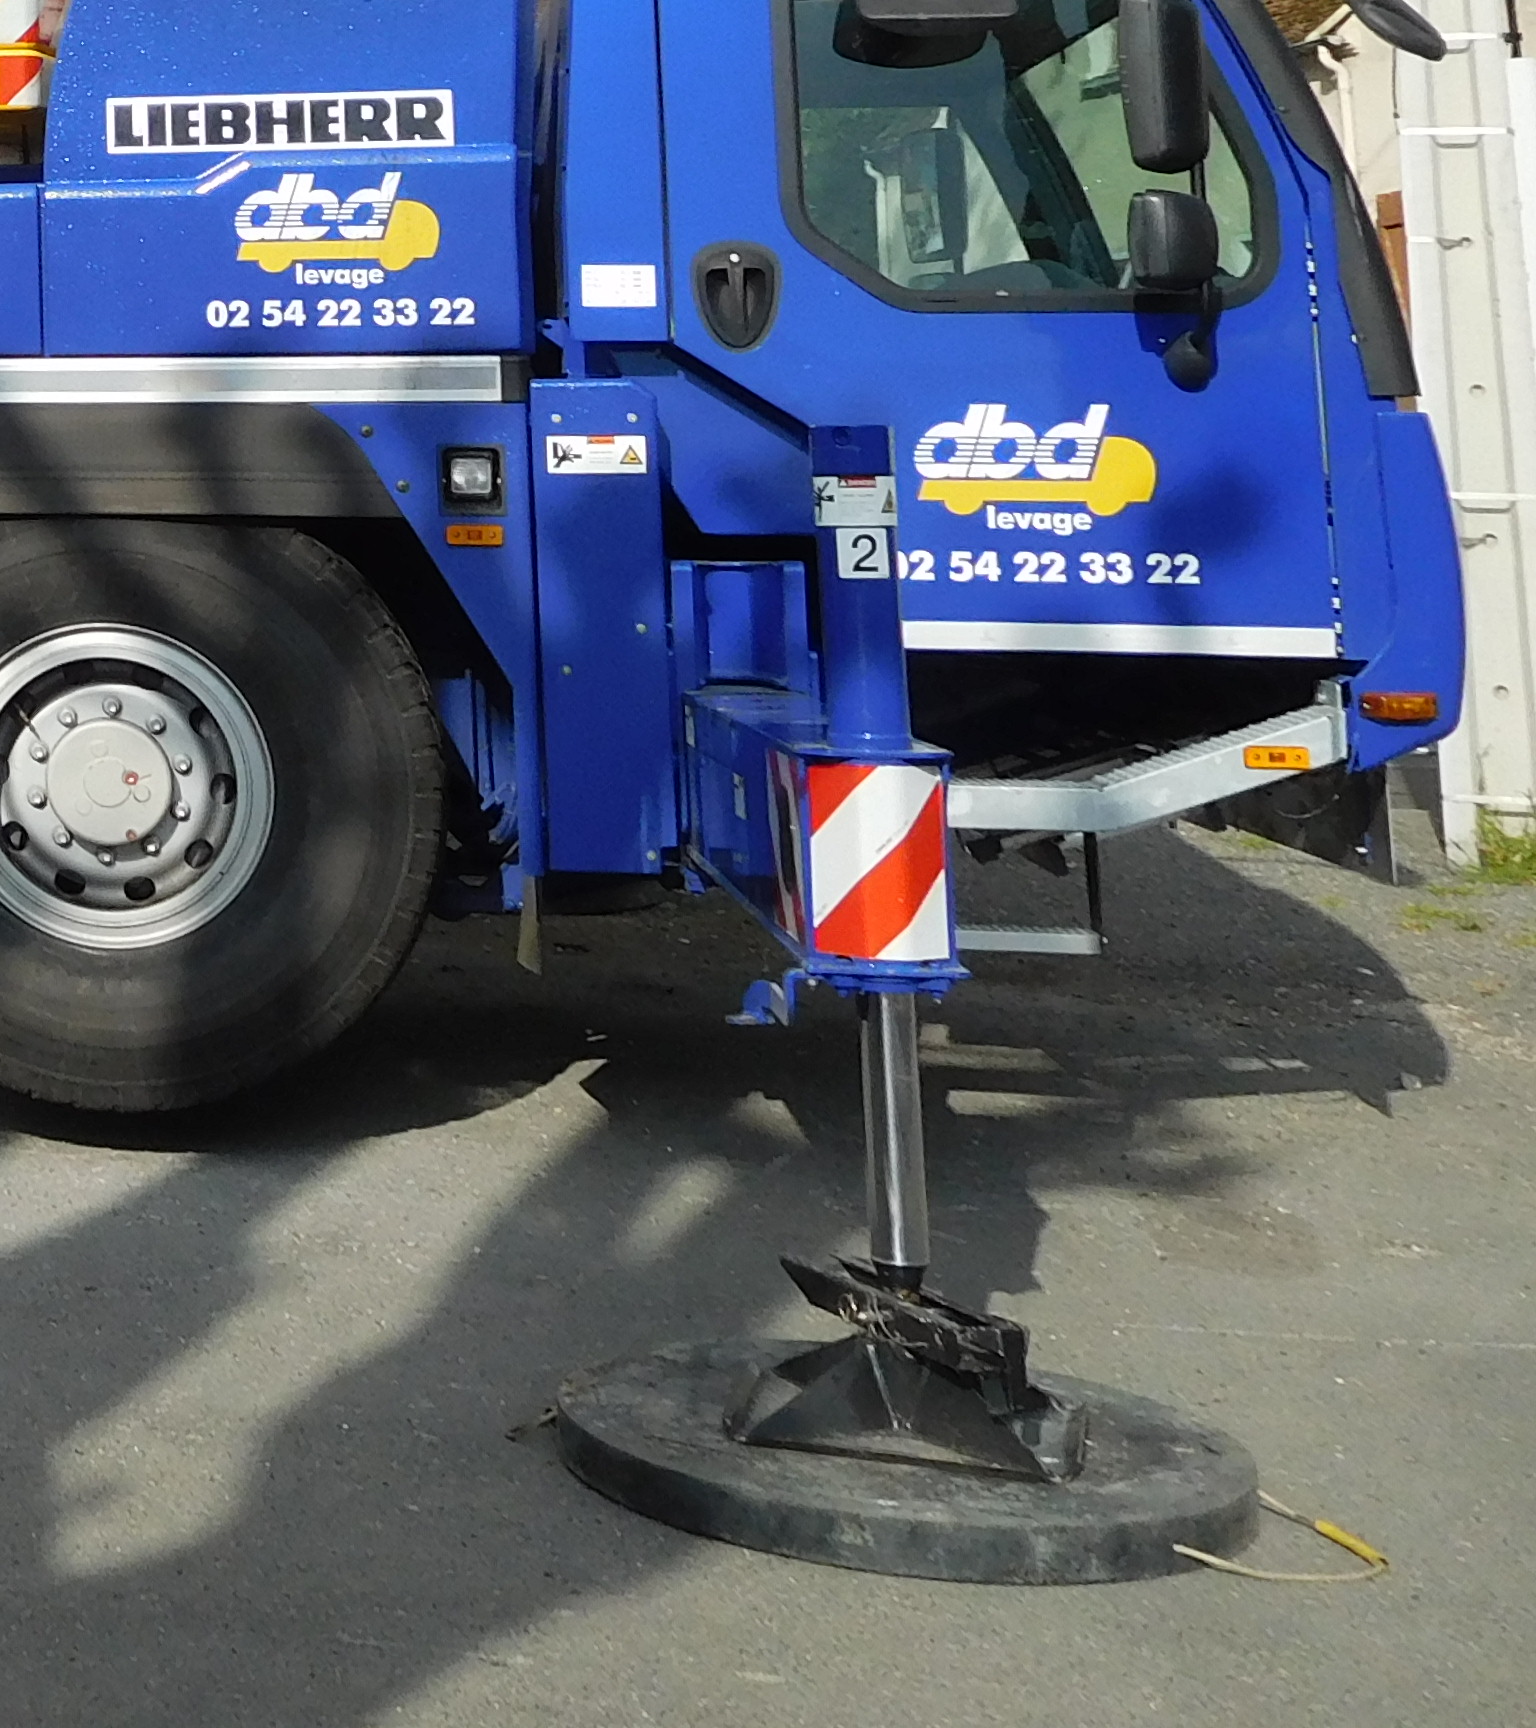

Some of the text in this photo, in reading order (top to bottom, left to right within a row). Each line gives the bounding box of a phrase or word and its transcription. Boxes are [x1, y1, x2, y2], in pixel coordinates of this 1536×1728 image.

[113, 98, 446, 147] LIEBHERR
[235, 171, 403, 241] dbd
[295, 263, 385, 289] levage
[207, 297, 475, 328] 02 54 22 33 22
[913, 403, 1110, 480] dbd
[986, 504, 1093, 536] levage
[851, 533, 879, 573] 2
[949, 550, 1002, 583] 54
[1013, 551, 1067, 583] 22
[1080, 552, 1134, 585] 33
[1146, 553, 1201, 584] 22
